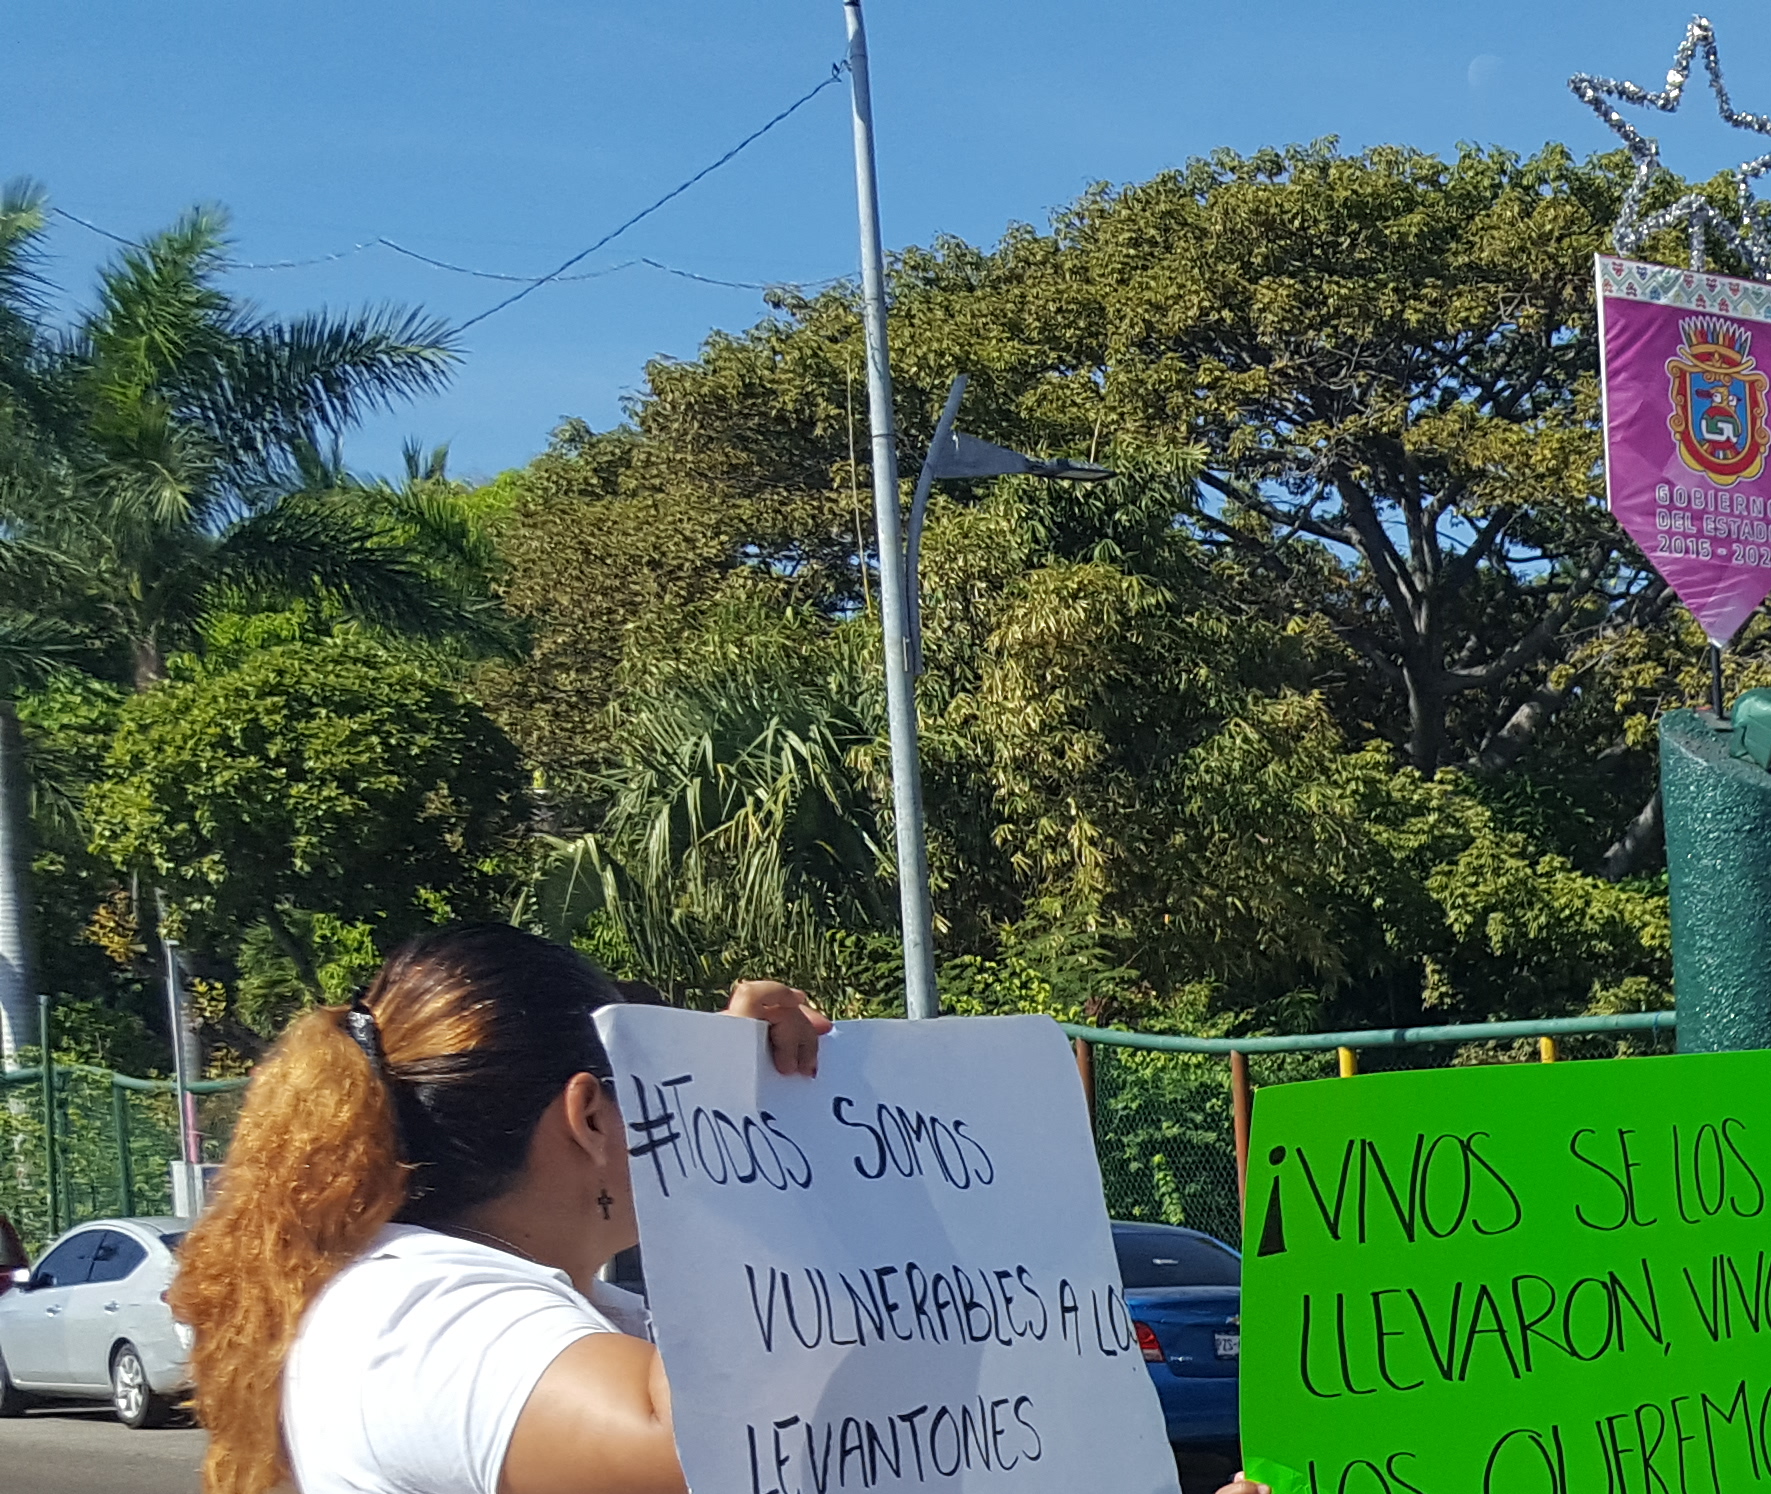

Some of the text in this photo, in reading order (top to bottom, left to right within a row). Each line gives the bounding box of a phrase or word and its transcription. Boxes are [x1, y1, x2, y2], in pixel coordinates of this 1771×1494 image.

[1656, 508, 1697, 534] DEL
[1657, 534, 1712, 560] 2015
[629, 1074, 994, 1197] #TODOS SOMOS
[1570, 1128, 1657, 1231] SE
[1672, 1117, 1764, 1224] LOS
[744, 1263, 1047, 1353] VULNERABLES
[1059, 1278, 1082, 1355] A
[1300, 1257, 1672, 1398] LLEVARON,
